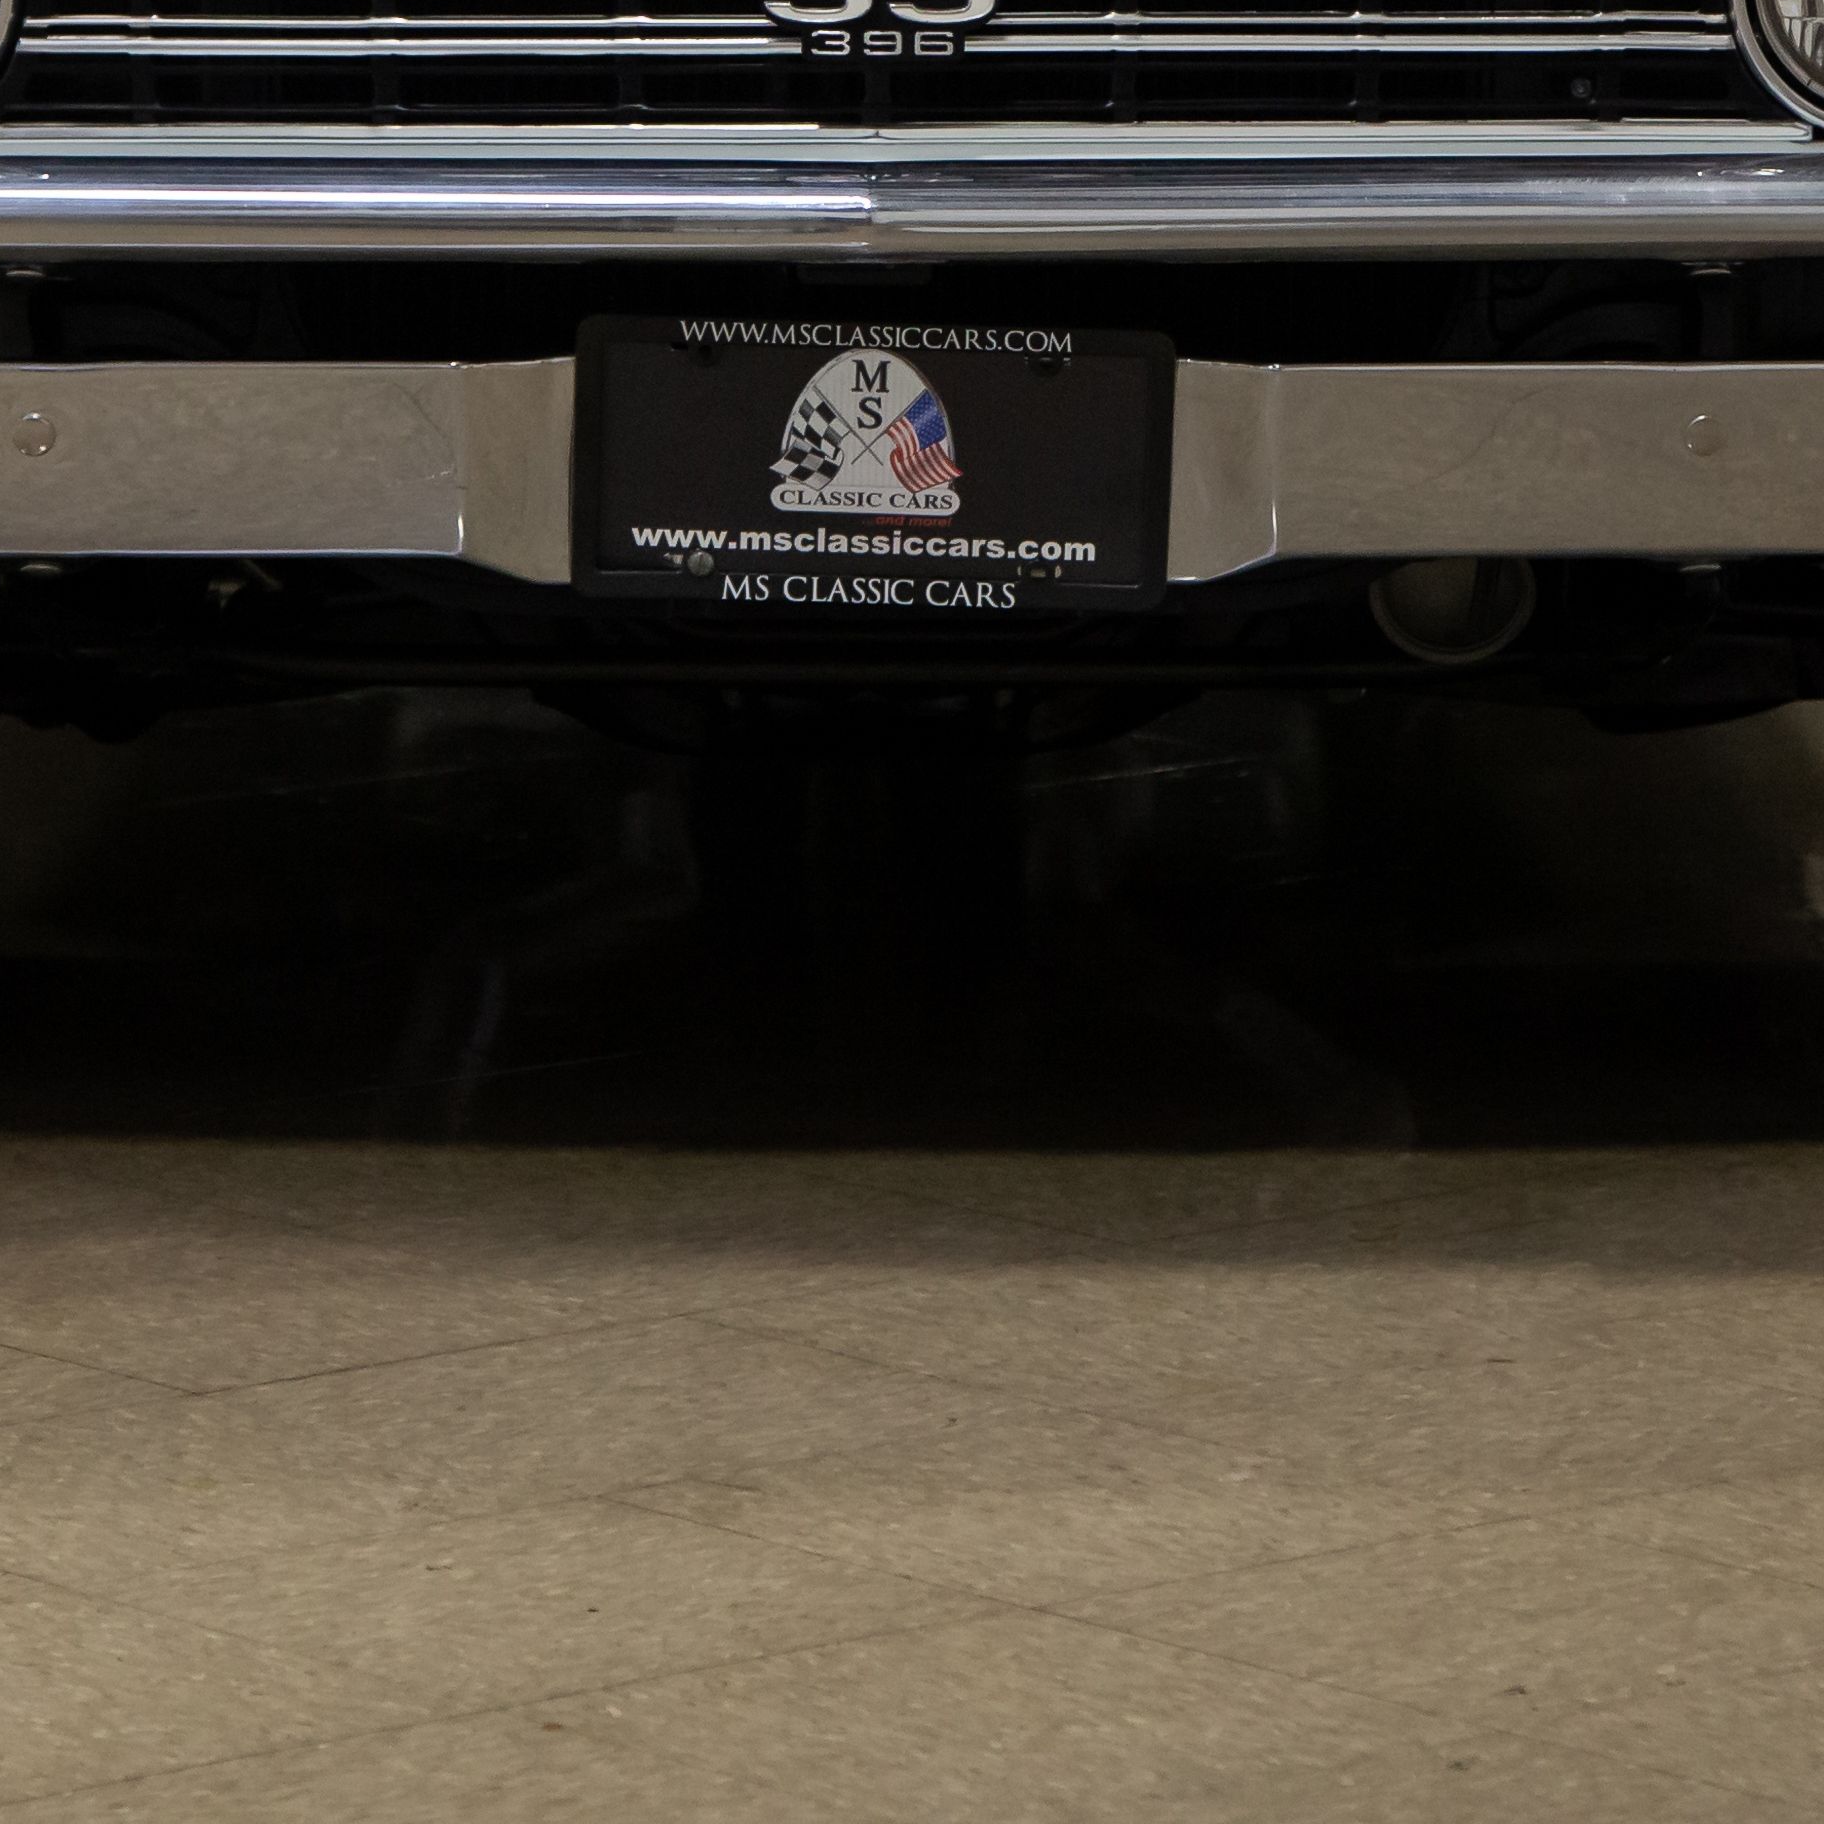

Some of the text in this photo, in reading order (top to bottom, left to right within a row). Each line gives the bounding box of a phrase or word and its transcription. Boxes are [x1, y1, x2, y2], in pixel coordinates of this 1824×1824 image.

[810, 30, 954, 56] 396
[680, 320, 1073, 353] WWW.MSCLASSICCARS.COM
[779, 490, 953, 510] CLASSIC CARS
[631, 527, 1096, 562] www.msclassiccars.com
[721, 575, 1016, 609] MS CLASSIC CARS
